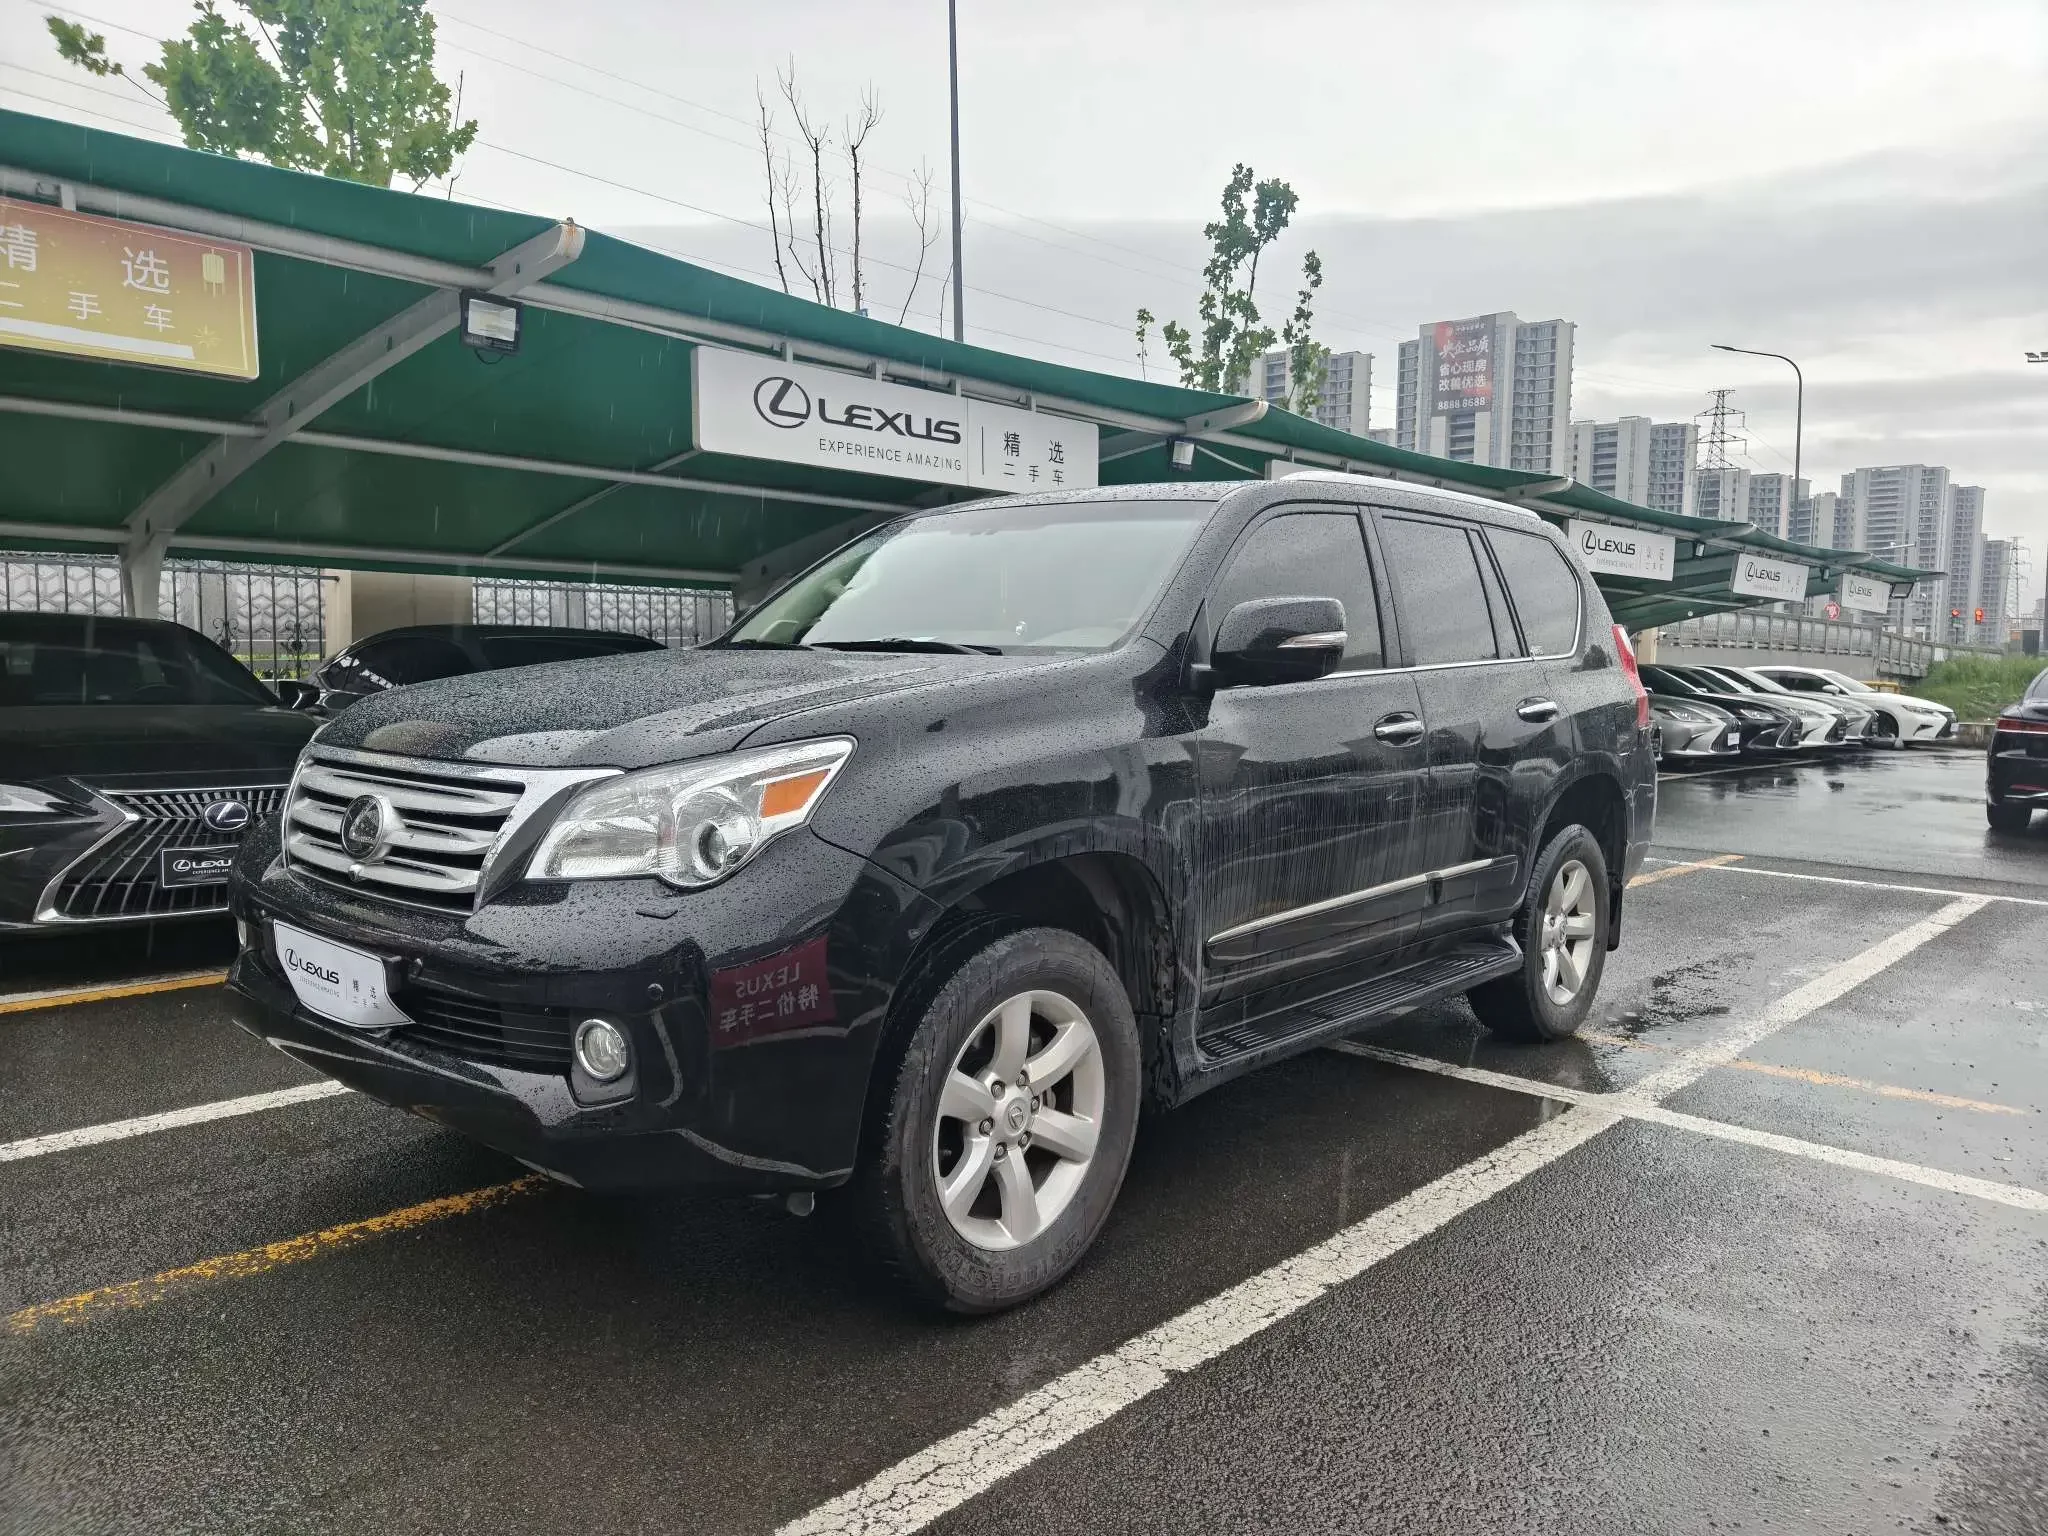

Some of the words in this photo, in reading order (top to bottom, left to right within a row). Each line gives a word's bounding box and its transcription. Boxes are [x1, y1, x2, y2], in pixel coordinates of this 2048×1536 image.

[818, 398, 961, 445] LEXUS
[819, 438, 901, 462] EXPERIENCE
[906, 452, 962, 471] AMAZING
[1003, 430, 1065, 465] 精选
[1003, 463, 1065, 486] 二手车
[1598, 538, 1635, 556] LEXUS
[1755, 568, 1781, 582] LEXUS
[192, 859, 232, 869] LEXU
[299, 958, 339, 985] LEXUS
